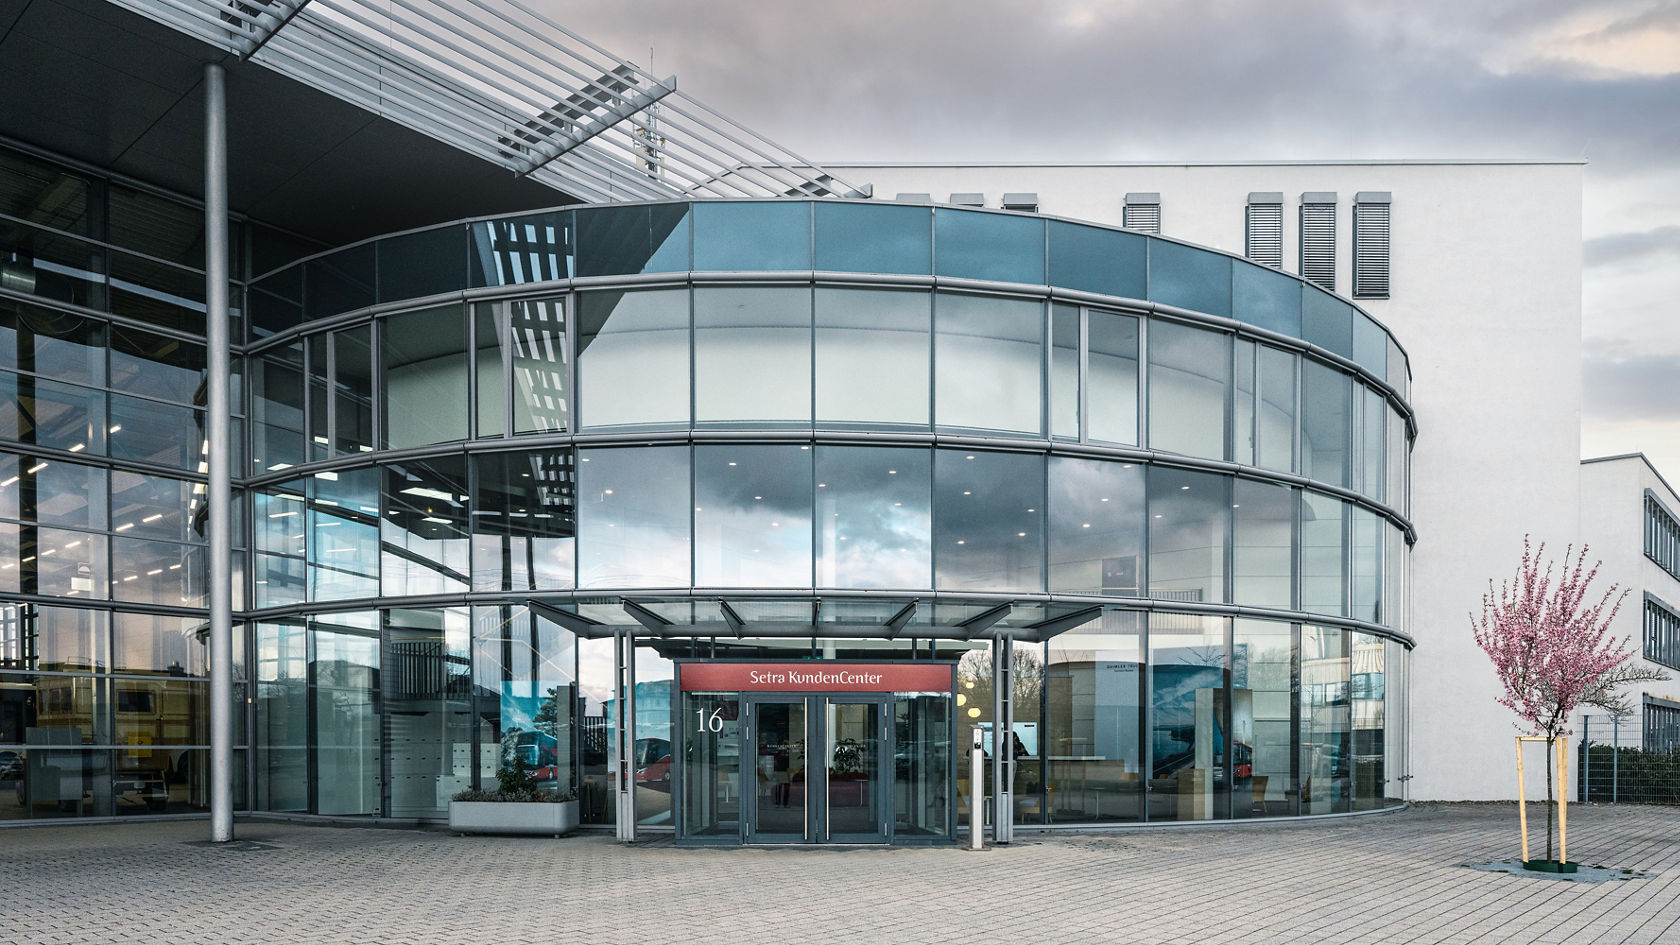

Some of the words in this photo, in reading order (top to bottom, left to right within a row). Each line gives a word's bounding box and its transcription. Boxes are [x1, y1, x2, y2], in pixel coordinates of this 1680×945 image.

[750, 670, 785, 684] Setra
[788, 670, 883, 684] KundenCenter
[696, 707, 723, 732] 16
